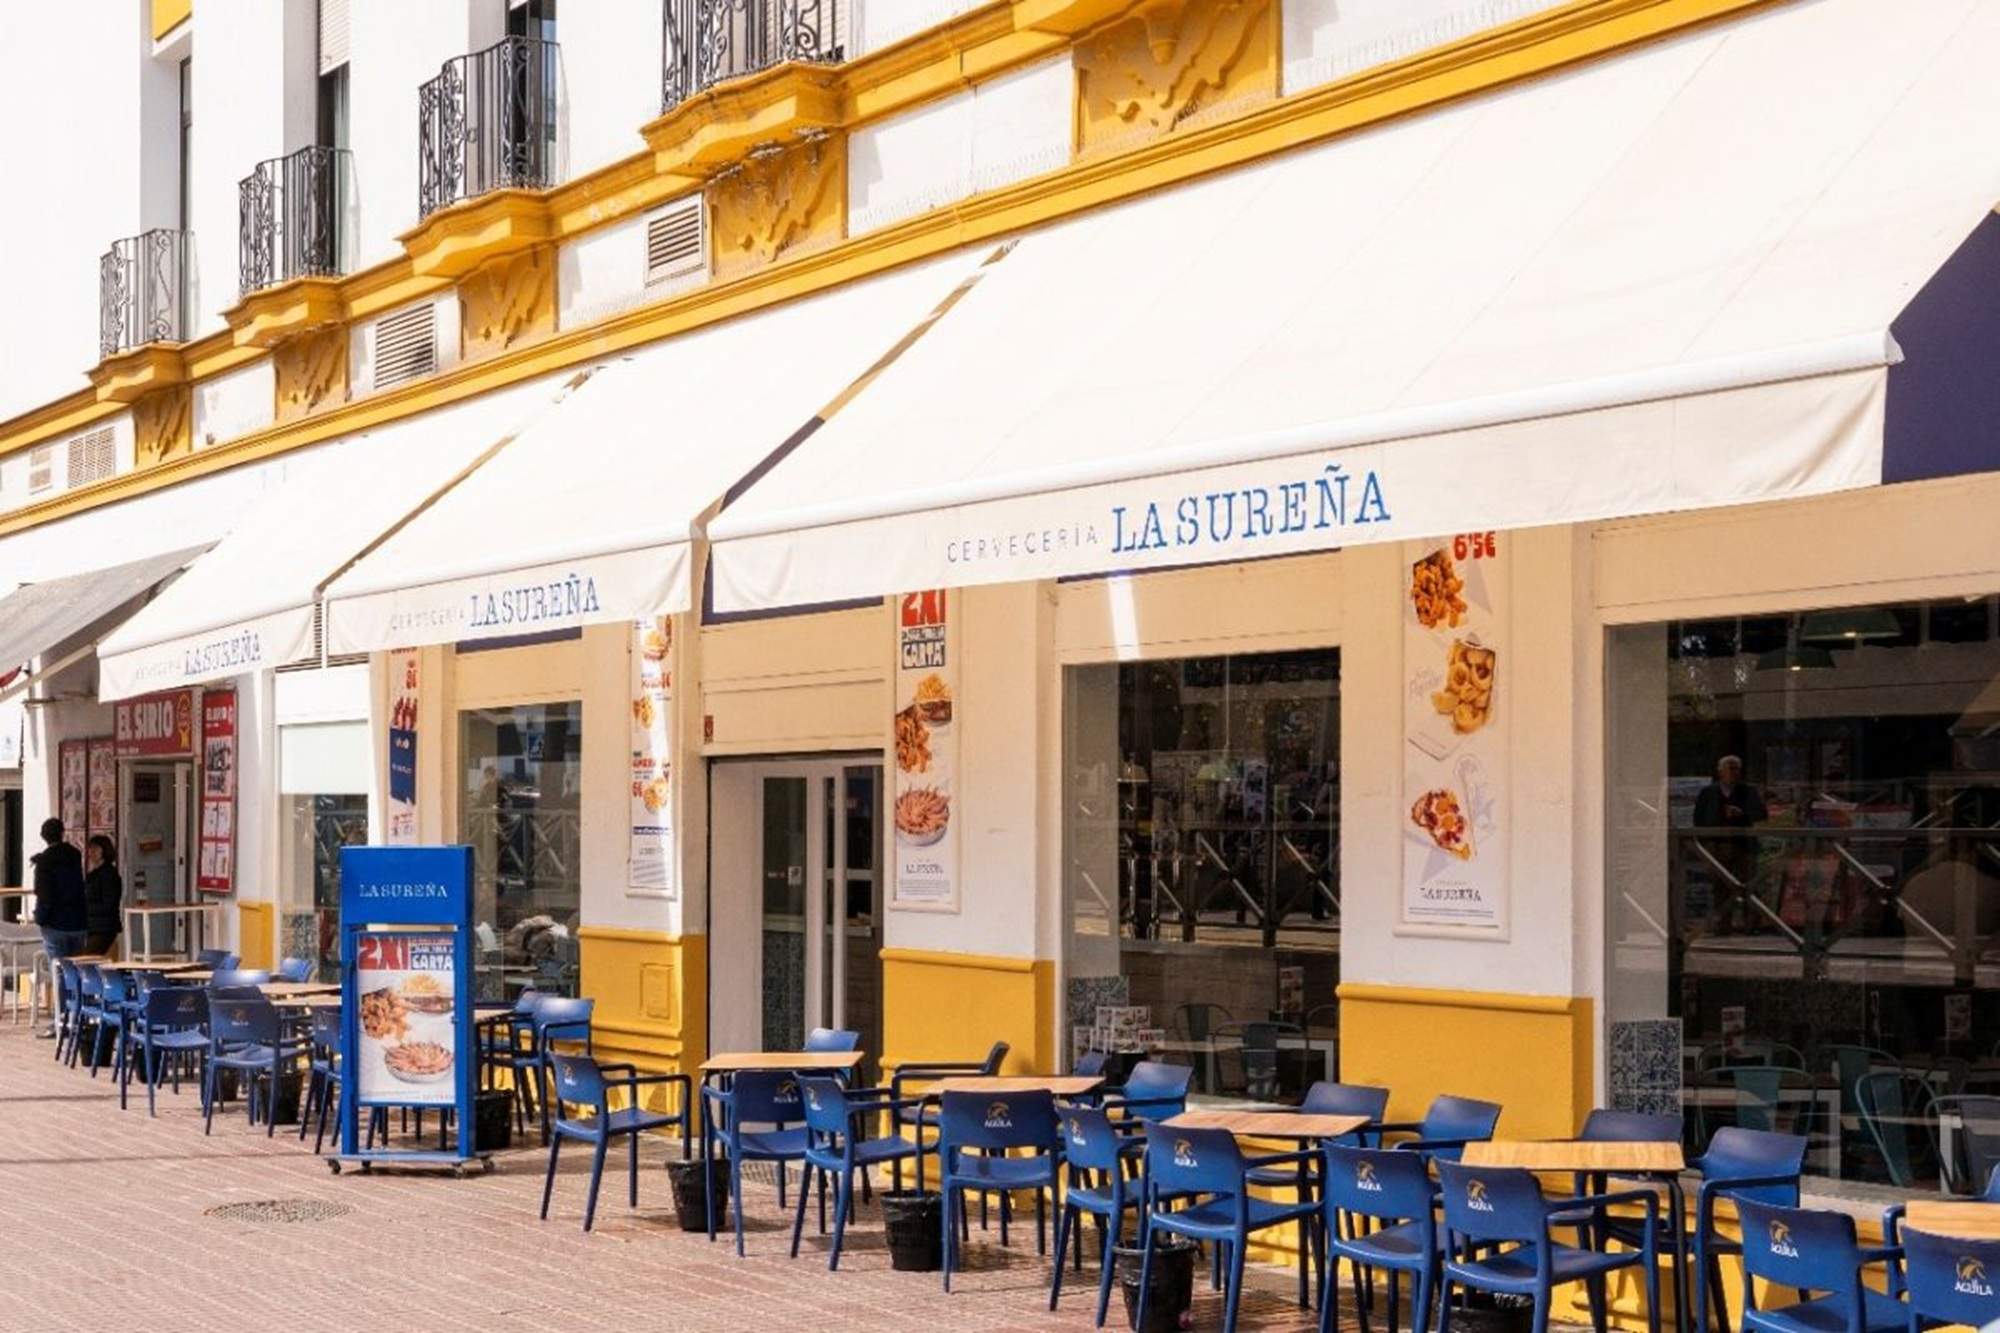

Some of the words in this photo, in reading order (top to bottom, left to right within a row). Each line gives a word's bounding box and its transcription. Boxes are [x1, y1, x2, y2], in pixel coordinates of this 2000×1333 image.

[947, 525, 1098, 563] CERVECERÍA
[1111, 464, 1391, 553] LASUREÑA
[470, 573, 600, 627] LASUREÑA
[117, 704, 133, 741] EL
[134, 700, 174, 740] SIRIO
[359, 882, 448, 898] LASUREÑA
